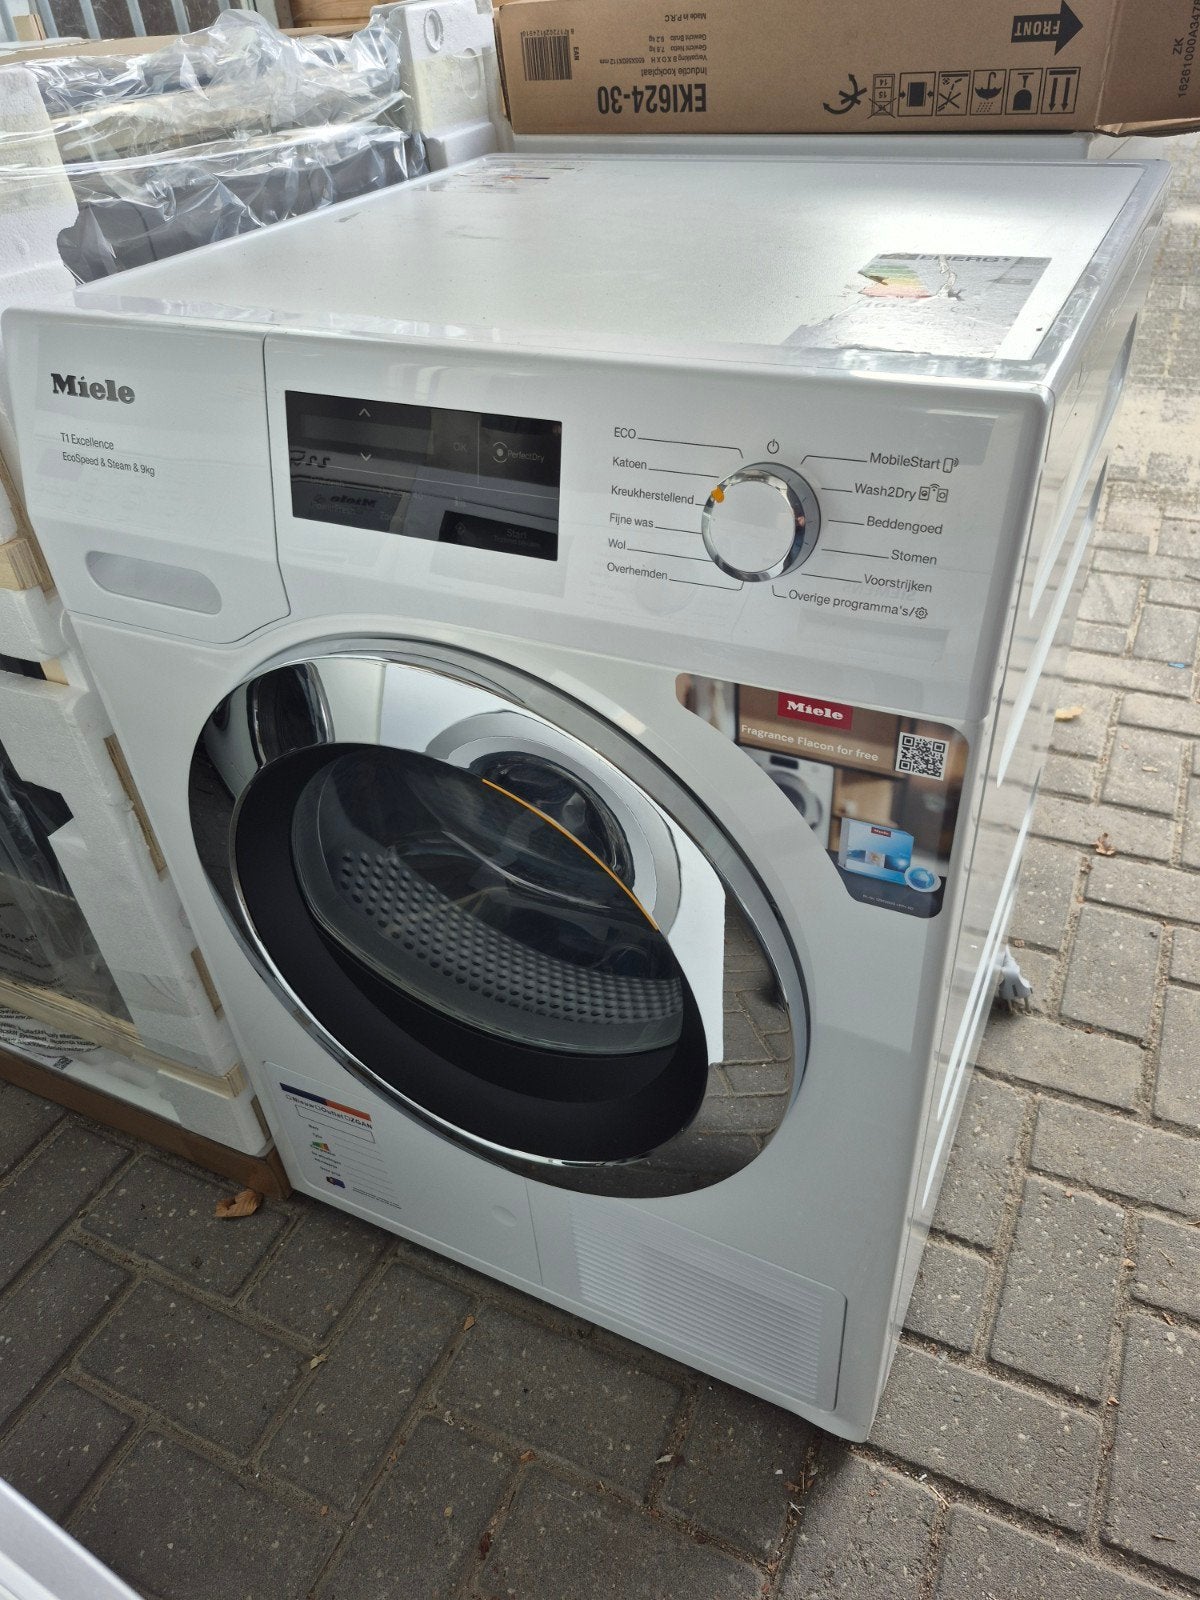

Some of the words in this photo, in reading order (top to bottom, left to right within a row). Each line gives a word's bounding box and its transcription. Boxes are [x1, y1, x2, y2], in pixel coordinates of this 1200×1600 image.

[690, 12, 707, 20] Made
[1014, 20, 1060, 36] FRONT
[669, 34, 685, 42] Bruto
[685, 33, 707, 41] Gewicht
[685, 44, 707, 52] Gewicht
[1172, 37, 1184, 55] ZK
[677, 54, 708, 62] Verpakking
[640, 67, 676, 78] kookplaat
[678, 66, 708, 76] Inductie
[597, 83, 707, 115] EKI624-30
[50, 373, 136, 405] Miele
[614, 426, 636, 440] ECO
[60, 432, 70, 443] T1
[71, 433, 114, 451] Excellence
[454, 442, 467, 452] OK
[507, 449, 545, 463] PerfectDry
[612, 456, 647, 470] Katoen
[869, 452, 940, 470] MobileStart
[62, 452, 99, 467] EcoSpeed
[100, 457, 106, 468] &
[108, 459, 132, 472] Steam
[133, 463, 139, 473] &
[140, 464, 156, 478] 9kg
[610, 484, 695, 505] Kreukherstellend
[854, 482, 916, 502] Wash2Dry
[609, 512, 632, 526] Fijne
[634, 518, 654, 528] was
[866, 516, 943, 535] Beddengoed
[608, 537, 626, 550] Wol
[890, 549, 938, 566] Stomen
[606, 562, 668, 580] Overhemden
[864, 574, 932, 593] Voorstrijken
[788, 589, 831, 606] Overige
[786, 700, 844, 721] Miele
[740, 724, 795, 747] Fragrance
[797, 736, 834, 753] Flacon
[836, 743, 853, 756] for
[855, 746, 880, 762] free
[350, 1116, 373, 1130] ZGAN
